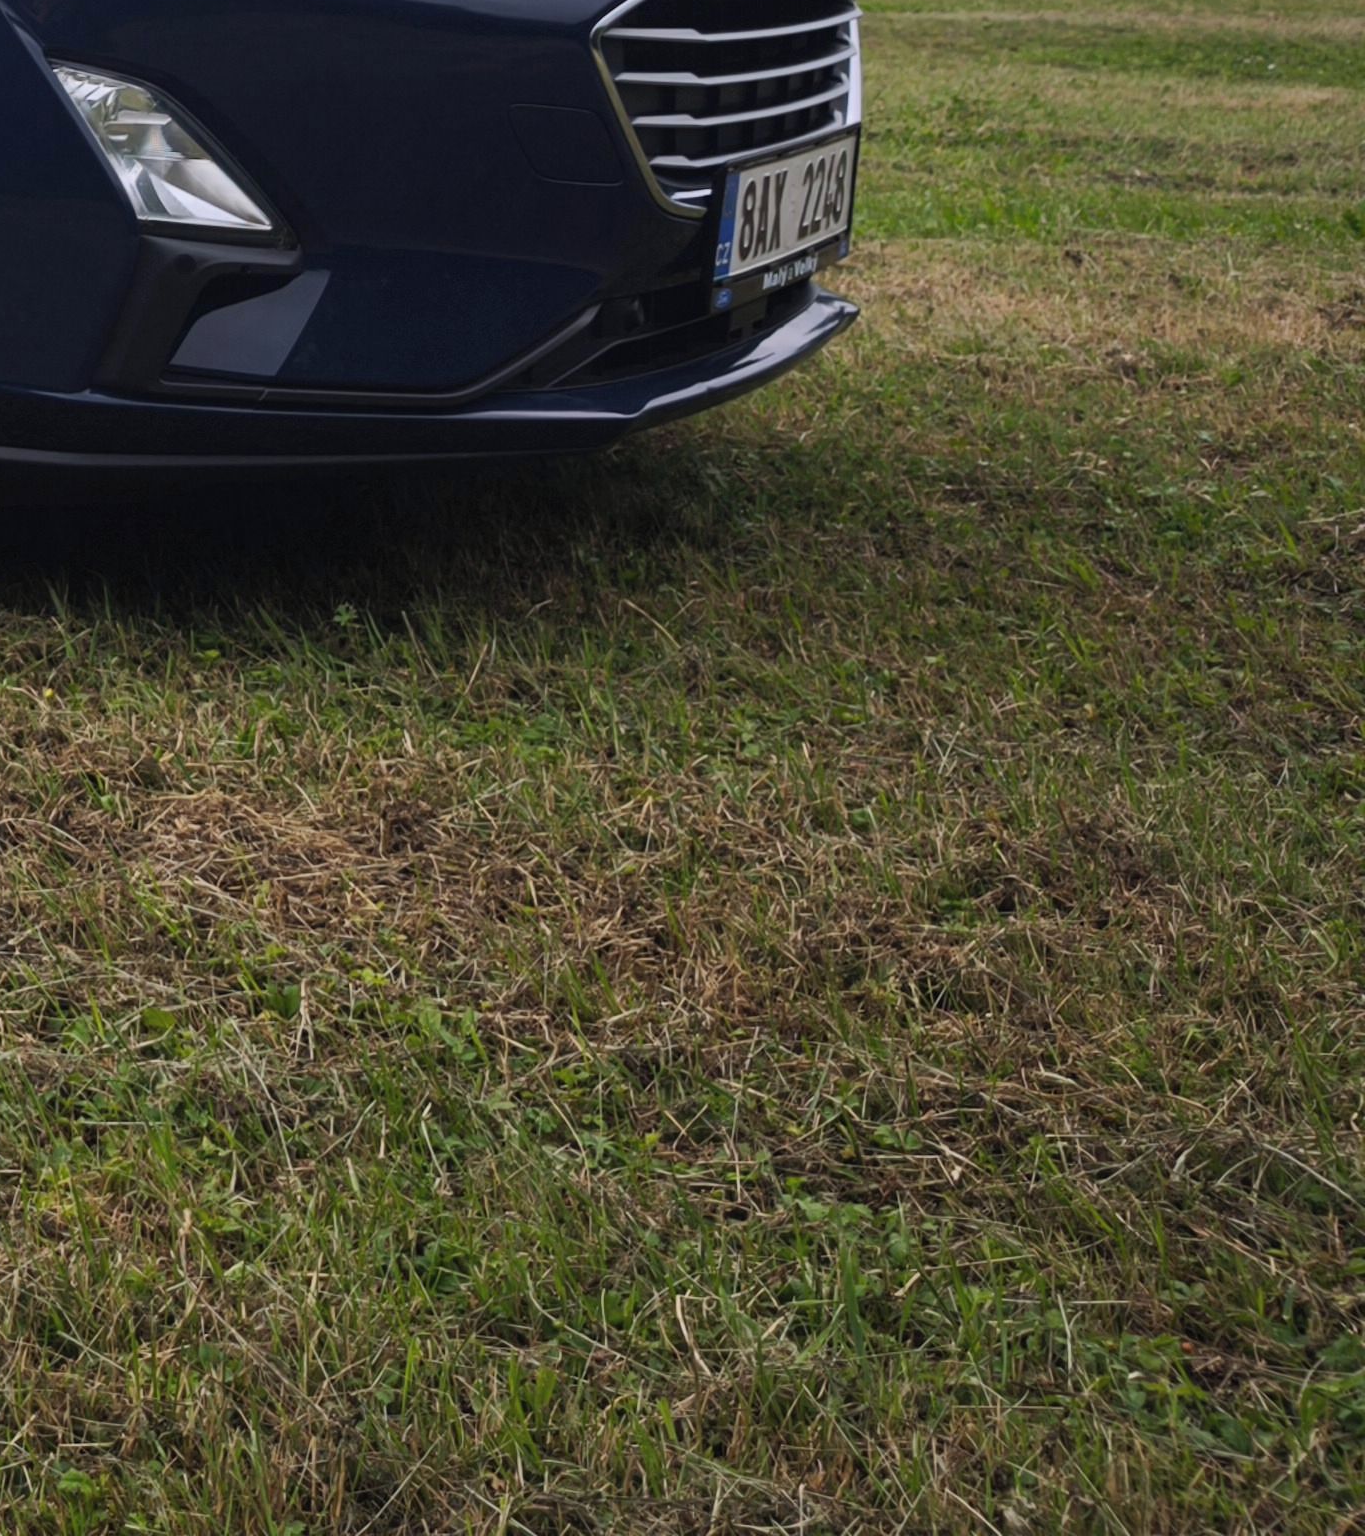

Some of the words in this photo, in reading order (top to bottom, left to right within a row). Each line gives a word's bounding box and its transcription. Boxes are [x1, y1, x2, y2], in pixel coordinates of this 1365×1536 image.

[739, 169, 789, 262] 8AX
[797, 149, 848, 241] 2248
[715, 241, 732, 267] CZ
